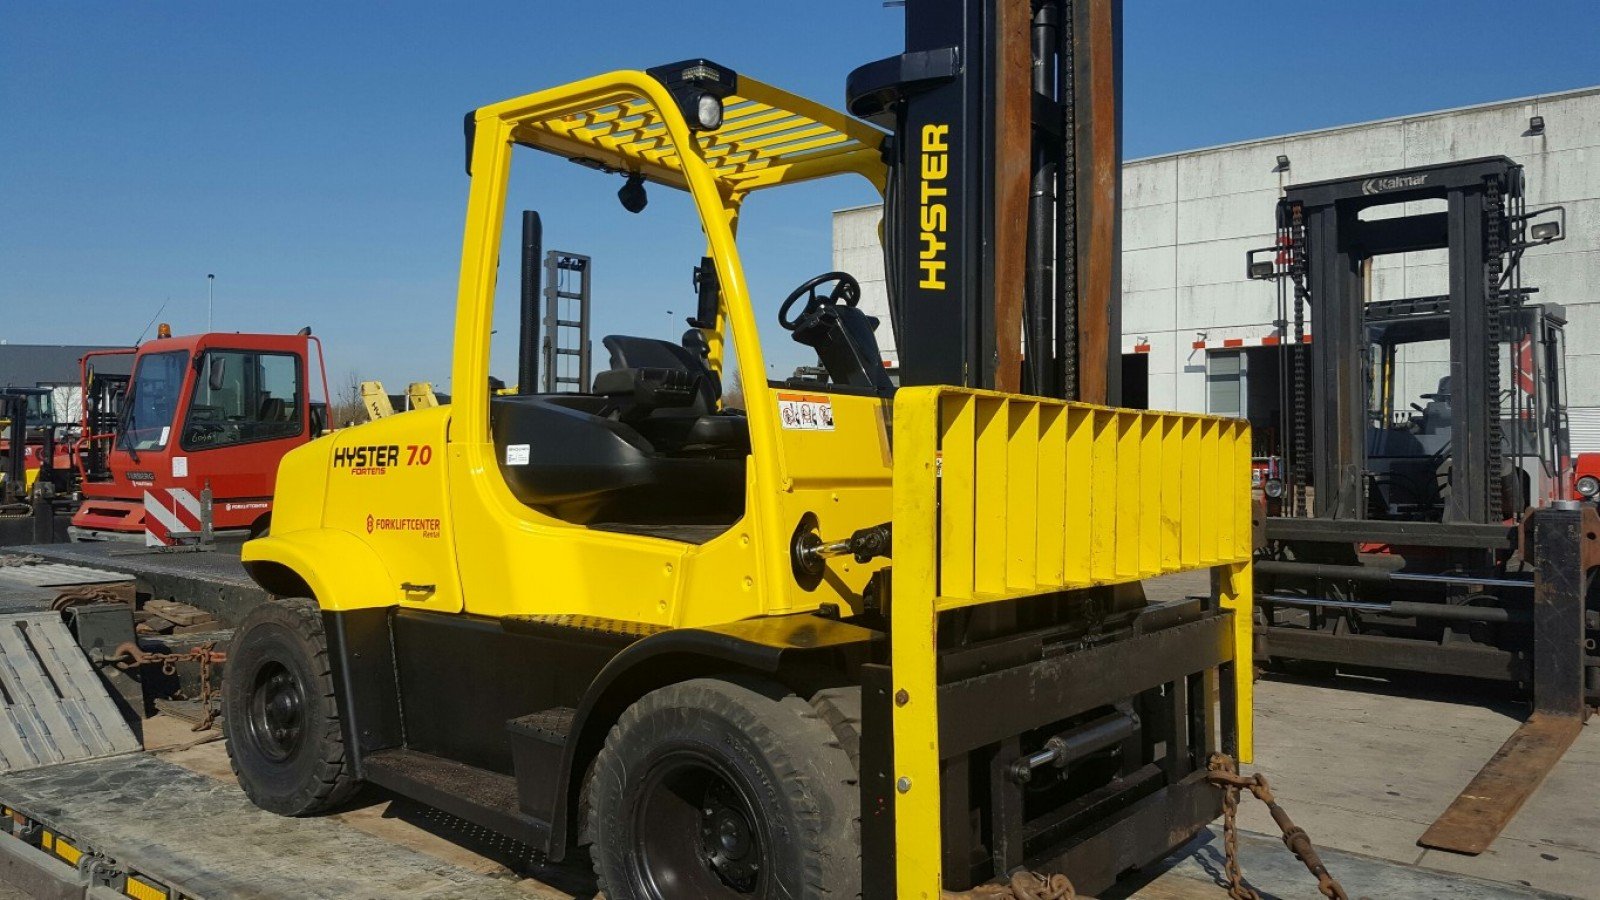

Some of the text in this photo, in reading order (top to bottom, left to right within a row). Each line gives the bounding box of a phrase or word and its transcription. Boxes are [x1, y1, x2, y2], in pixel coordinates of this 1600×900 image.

[1379, 174, 1428, 190] Kalmar
[919, 124, 949, 290] HYSTER
[334, 445, 432, 467] HYSTER 7.0
[376, 519, 440, 531] FORKLIFTCENTER
